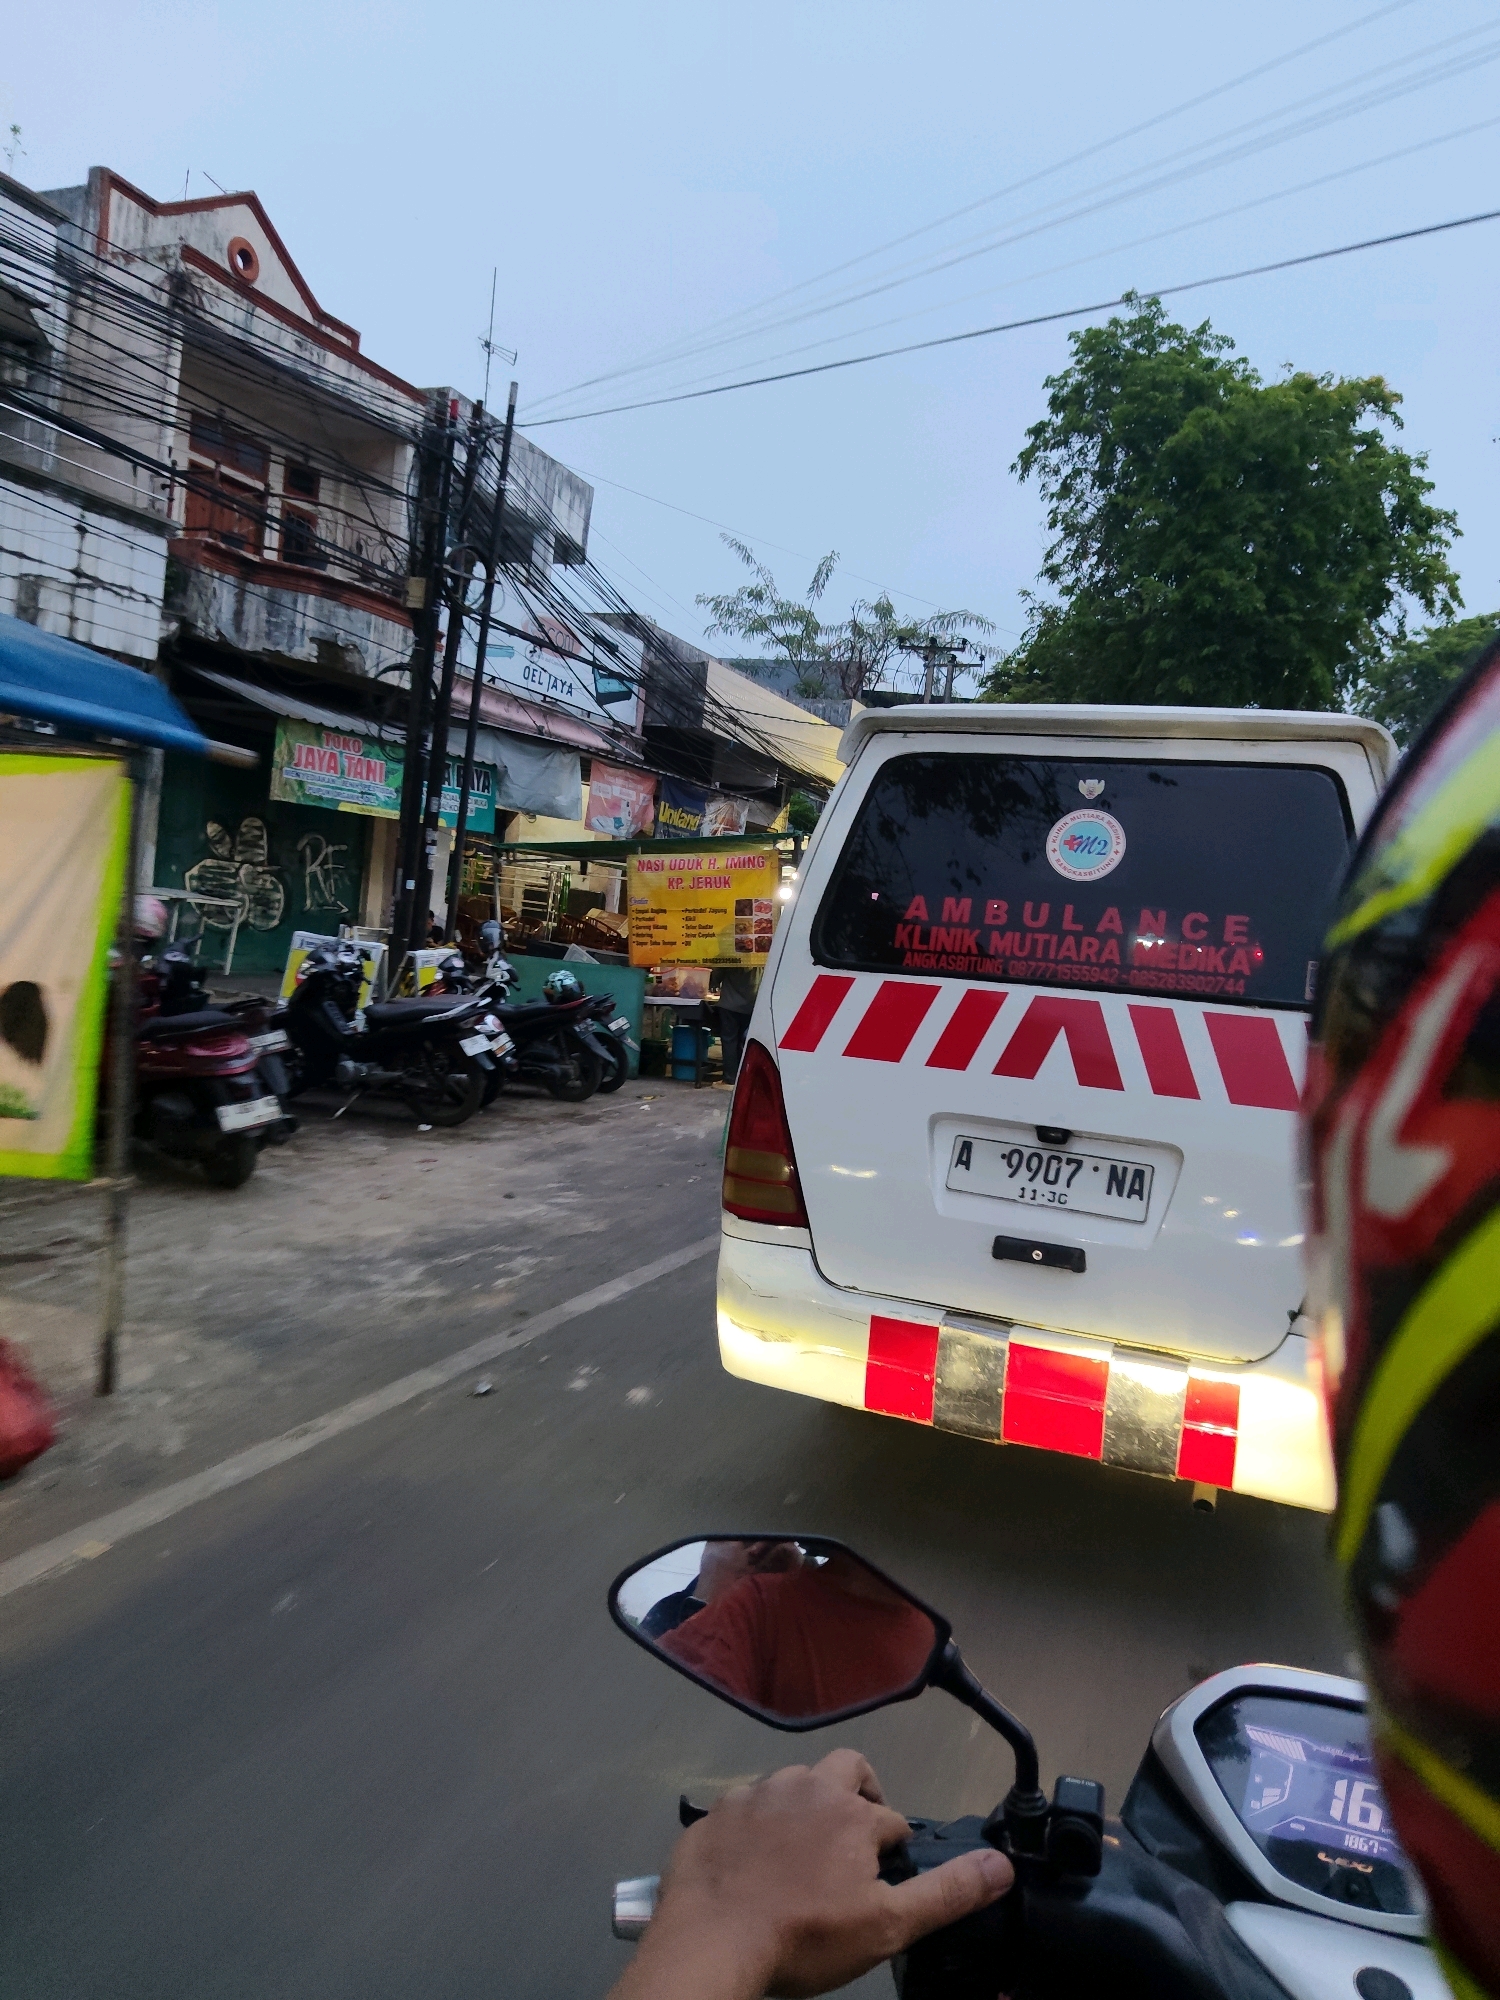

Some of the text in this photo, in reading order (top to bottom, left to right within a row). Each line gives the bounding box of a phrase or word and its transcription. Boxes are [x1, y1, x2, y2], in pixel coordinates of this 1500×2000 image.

[322, 731, 363, 755] TOKO
[293, 743, 386, 785] JAYA TANI
[1051, 813, 1121, 846] KLINIK MUTIARA MEDIKA
[637, 855, 766, 872] NASI UDUK H. IMING
[667, 876, 732, 890] KP. JERUK
[903, 894, 1250, 944] AMBULANCE
[894, 923, 1251, 976] KLINIK MUTIARA MEDIKA
[954, 1140, 1146, 1202] A 9907 NA
